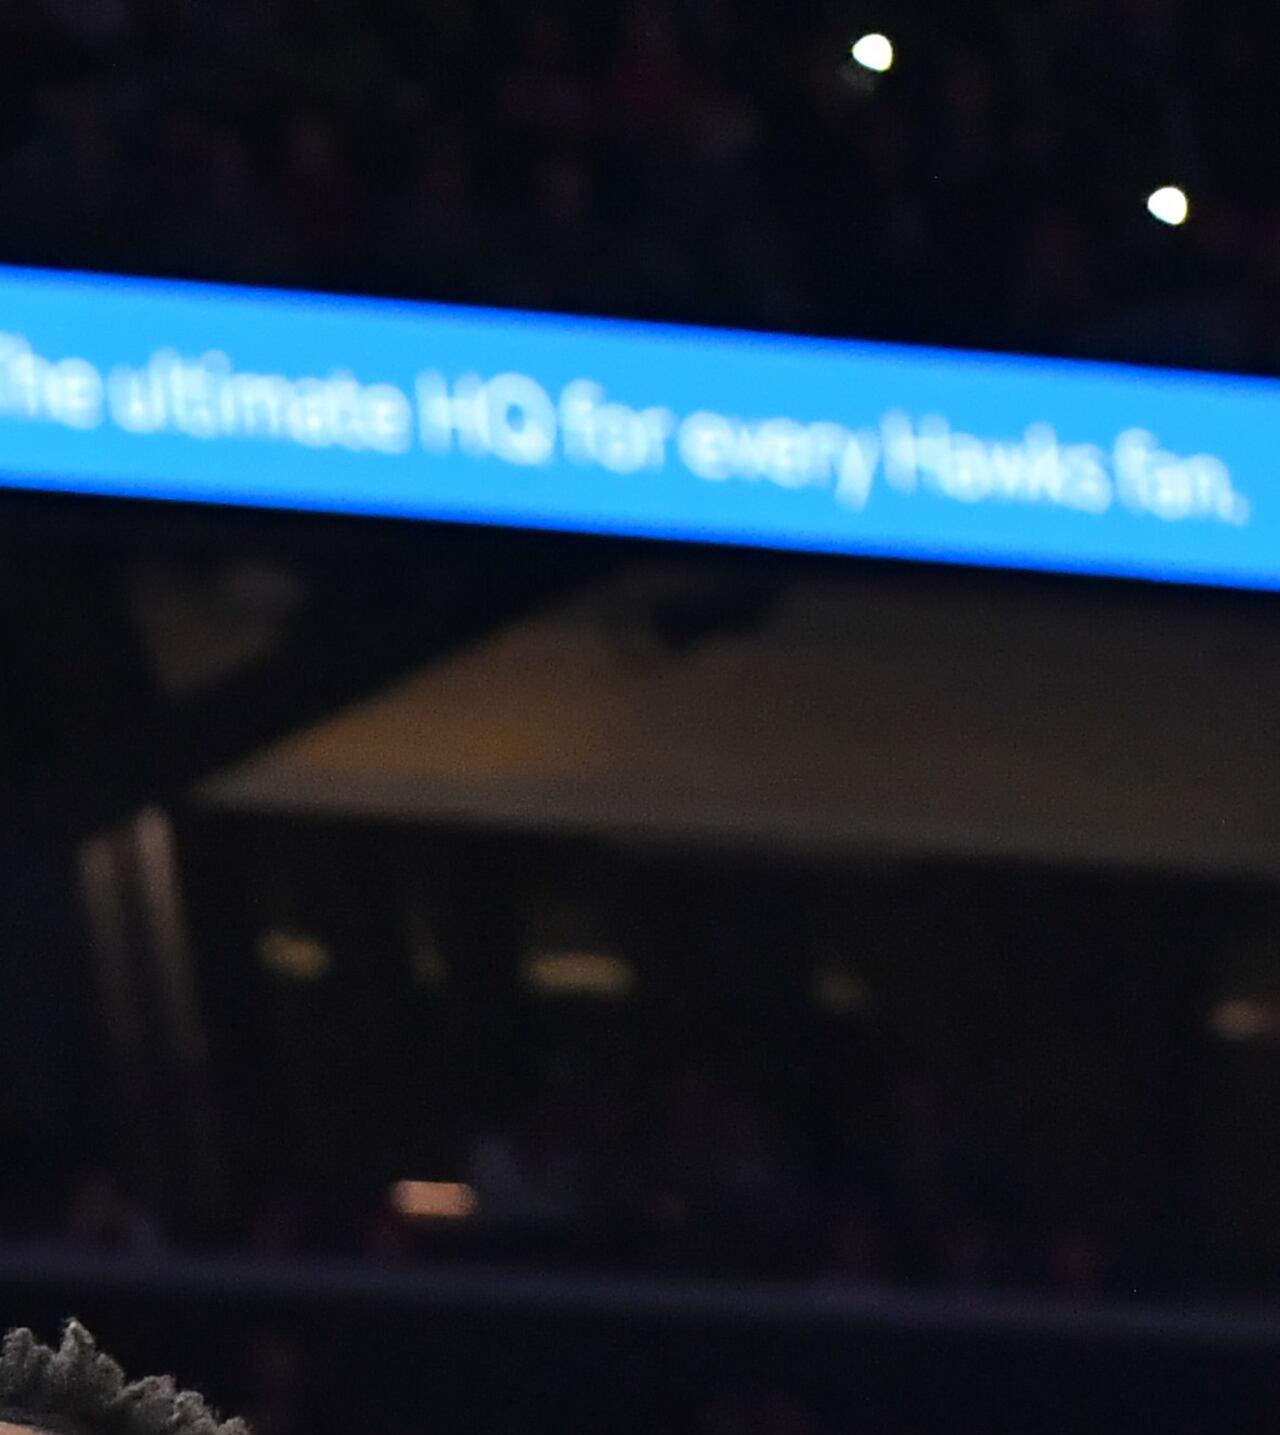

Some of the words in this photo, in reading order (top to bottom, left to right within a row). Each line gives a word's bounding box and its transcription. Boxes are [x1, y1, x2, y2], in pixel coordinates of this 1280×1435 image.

[108, 347, 412, 453] ultimate
[416, 371, 556, 466] HQ
[559, 379, 673, 474] for
[677, 411, 879, 512] every
[881, 408, 1112, 515] Hawks
